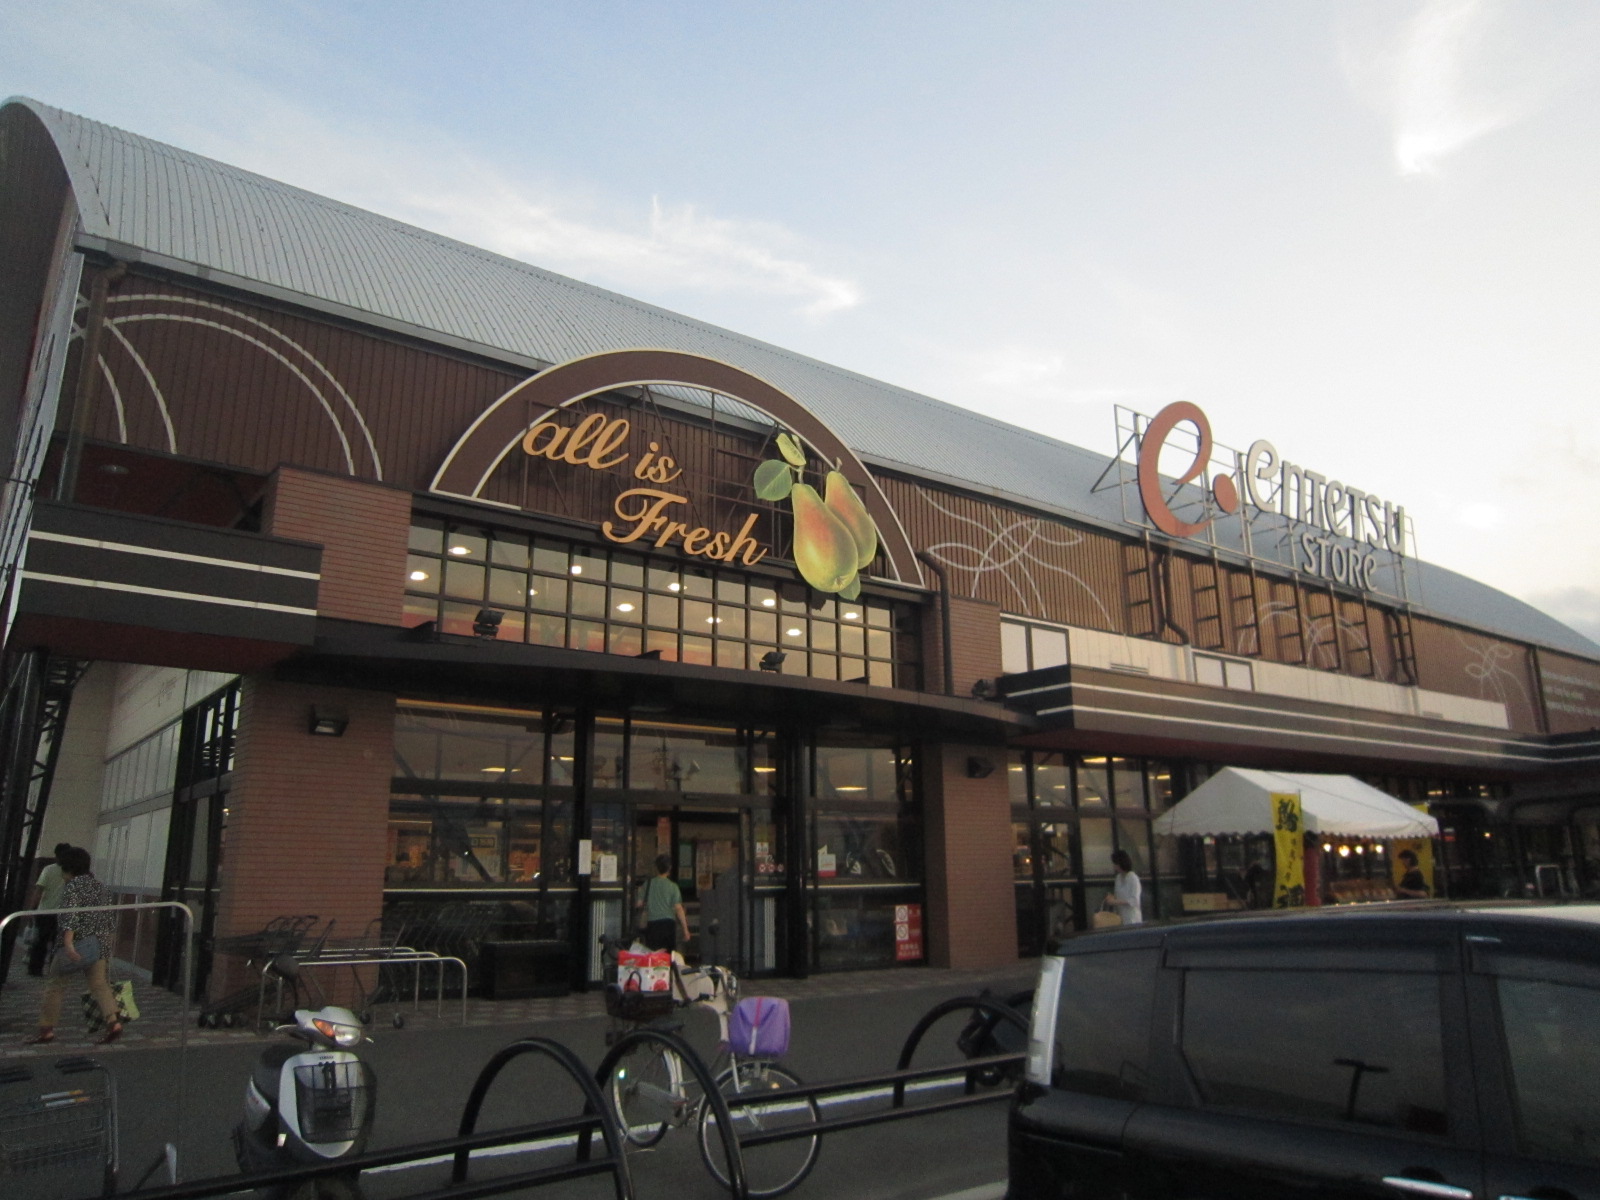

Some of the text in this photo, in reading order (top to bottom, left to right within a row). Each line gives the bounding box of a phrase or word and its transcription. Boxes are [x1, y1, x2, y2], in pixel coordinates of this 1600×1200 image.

[522, 413, 682, 483] all is
[602, 487, 768, 566] Fresh
